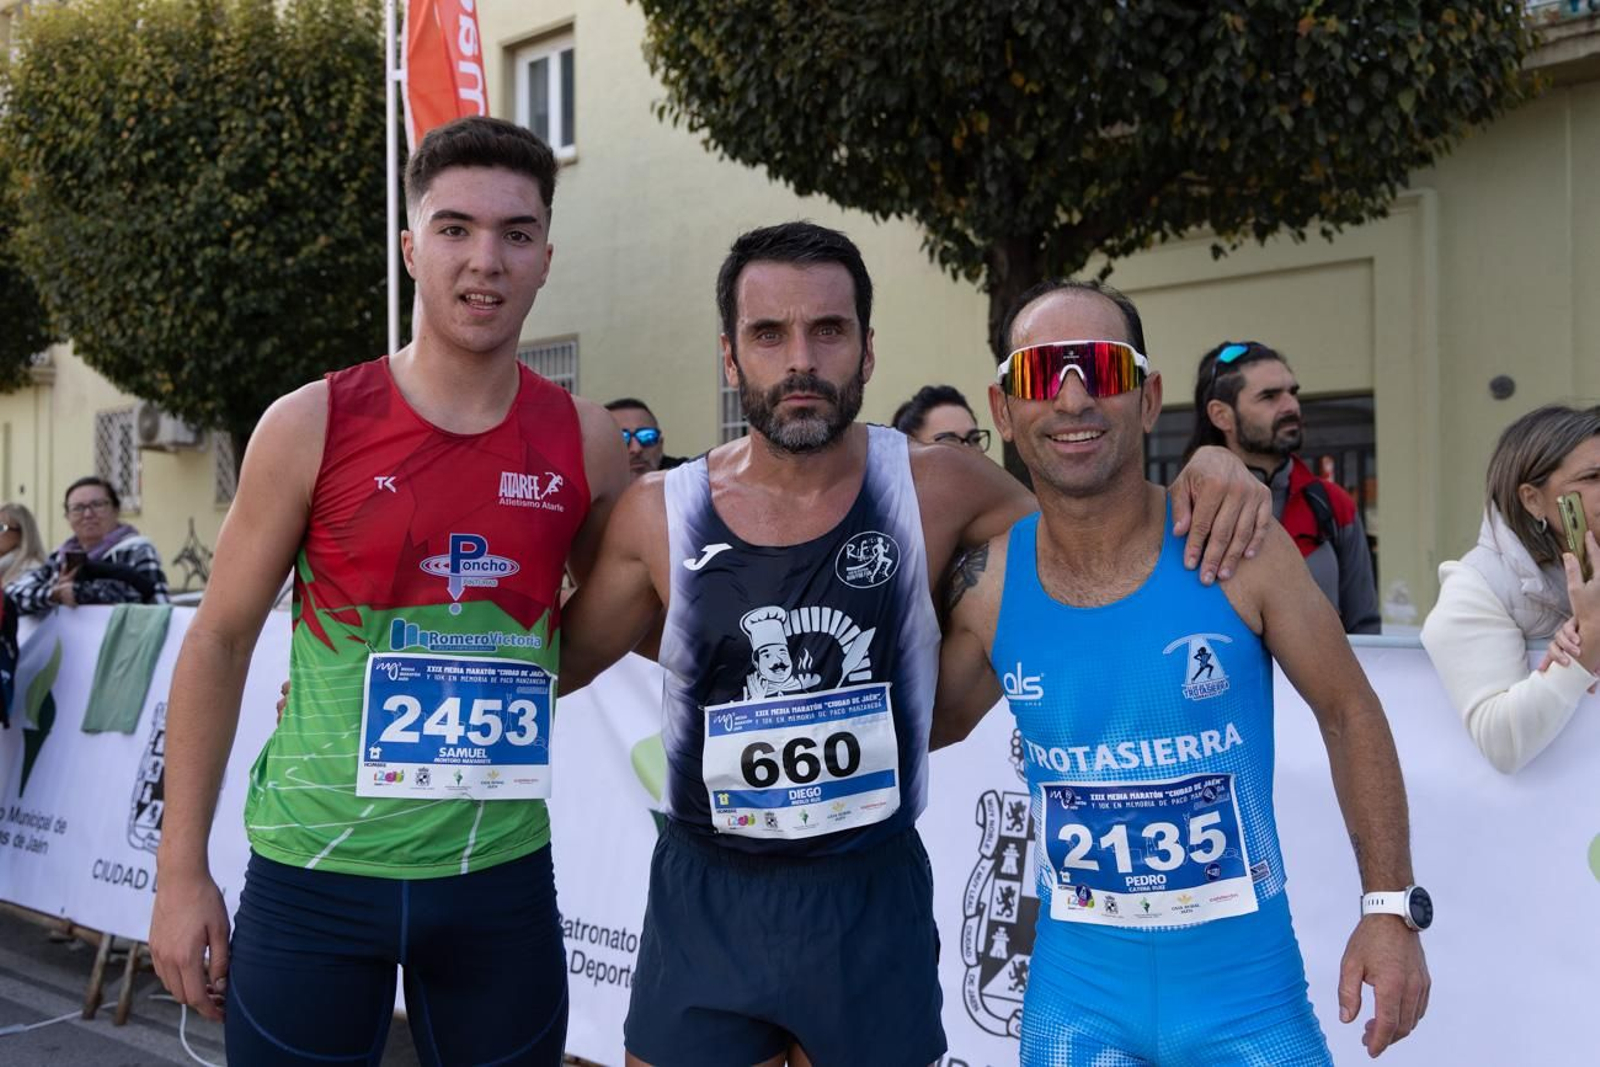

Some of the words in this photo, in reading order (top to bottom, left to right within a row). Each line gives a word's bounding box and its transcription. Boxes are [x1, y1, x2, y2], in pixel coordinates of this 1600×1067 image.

[499, 471, 541, 500] ATARFE
[499, 498, 540, 508] Atletismo
[541, 501, 564, 512] Atarfe
[450, 534, 508, 574] Poncho
[426, 665, 443, 673] XXIX
[444, 666, 464, 675] MEDIA
[466, 667, 496, 676] MARATÓN
[755, 709, 769, 717] XXIX
[770, 707, 790, 716] MEDIA
[791, 703, 822, 713] MARATÓN
[852, 696, 861, 704] DE
[788, 712, 815, 722] MEMORIA
[817, 710, 827, 718] DE
[830, 708, 846, 716] PACO
[380, 694, 538, 747] 2453
[439, 747, 488, 758] SAMUEL
[1025, 722, 1243, 773] TROTASIERRA
[740, 731, 861, 788] 660
[788, 786, 822, 801] DIEGO
[1090, 793, 1105, 801] XXIX
[1129, 790, 1164, 800] MARATÓN
[1193, 782, 1202, 791] DE
[1125, 800, 1155, 808] MEMORIA
[1158, 799, 1168, 807] DE
[1171, 796, 1188, 805] PACO
[53, 816, 67, 835] de
[1058, 810, 1227, 874] 2135
[92, 859, 149, 890] CIUDAD
[1125, 874, 1167, 887] PEDRO
[570, 949, 633, 988] Deport
